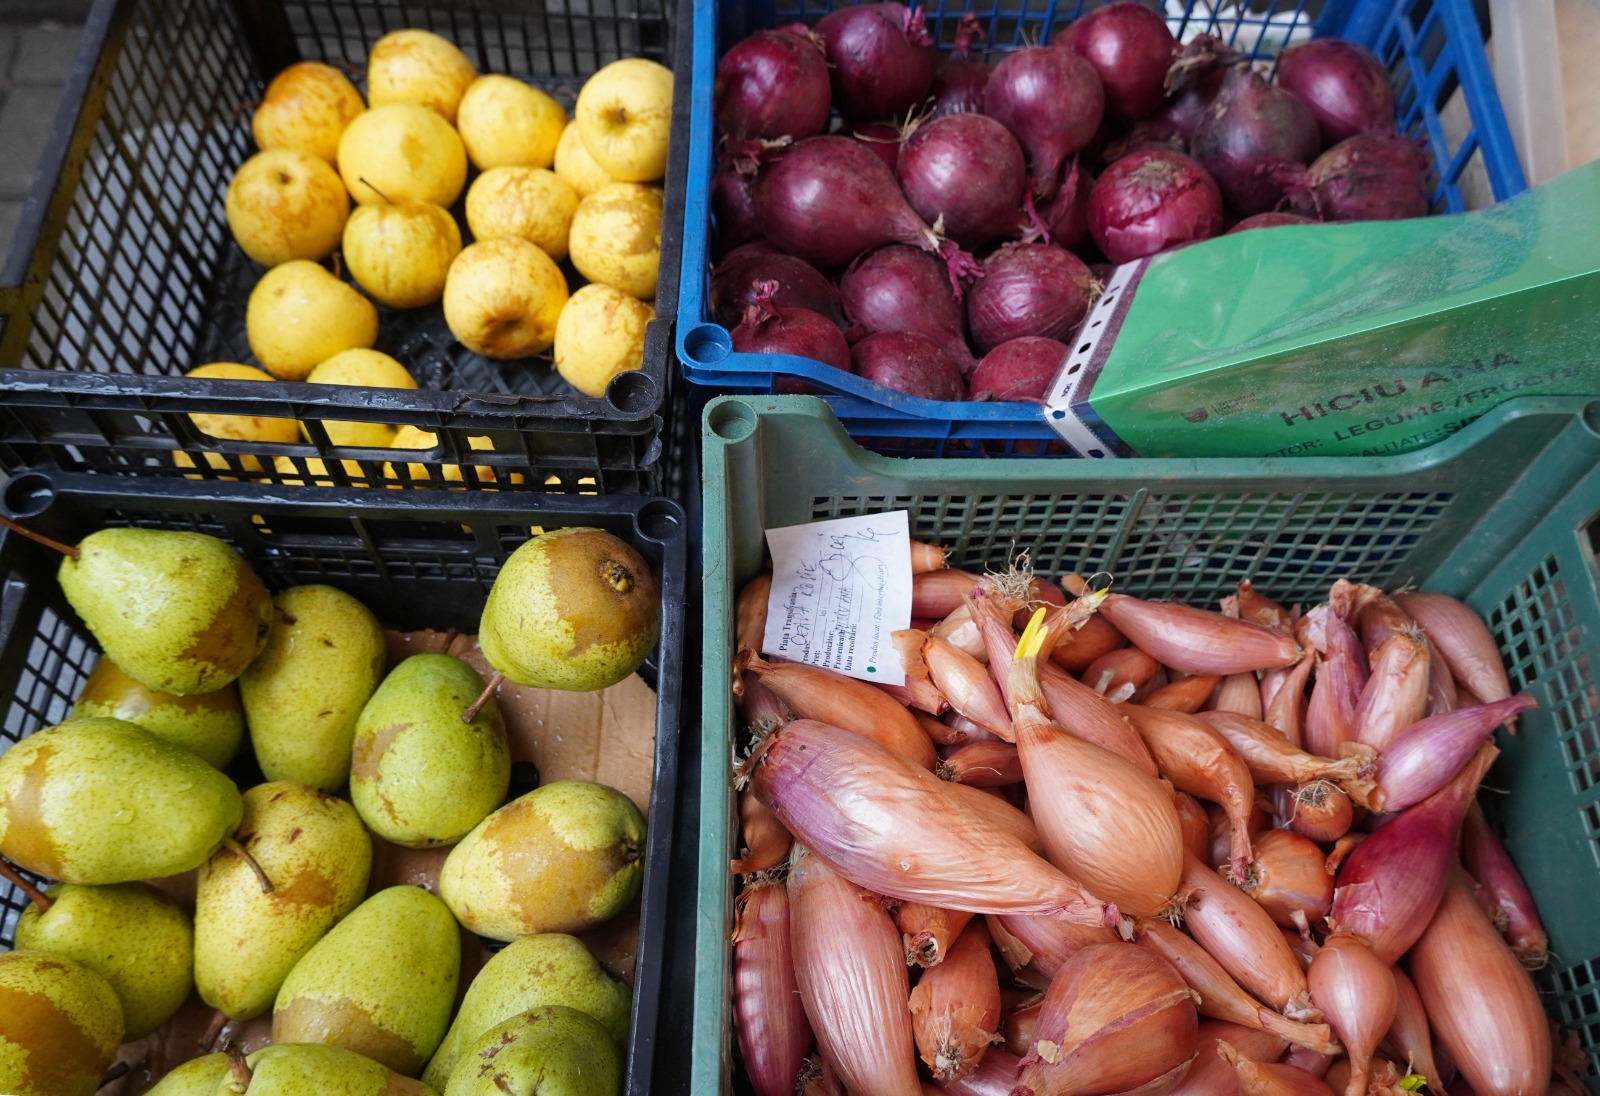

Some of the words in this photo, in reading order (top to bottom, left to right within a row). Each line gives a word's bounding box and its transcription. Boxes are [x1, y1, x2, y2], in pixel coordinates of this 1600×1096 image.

[1279, 379, 1408, 427] HICIU
[1420, 352, 1521, 389] ANA
[1332, 399, 1446, 442] LEGUME
[844, 655, 853, 671] Data
